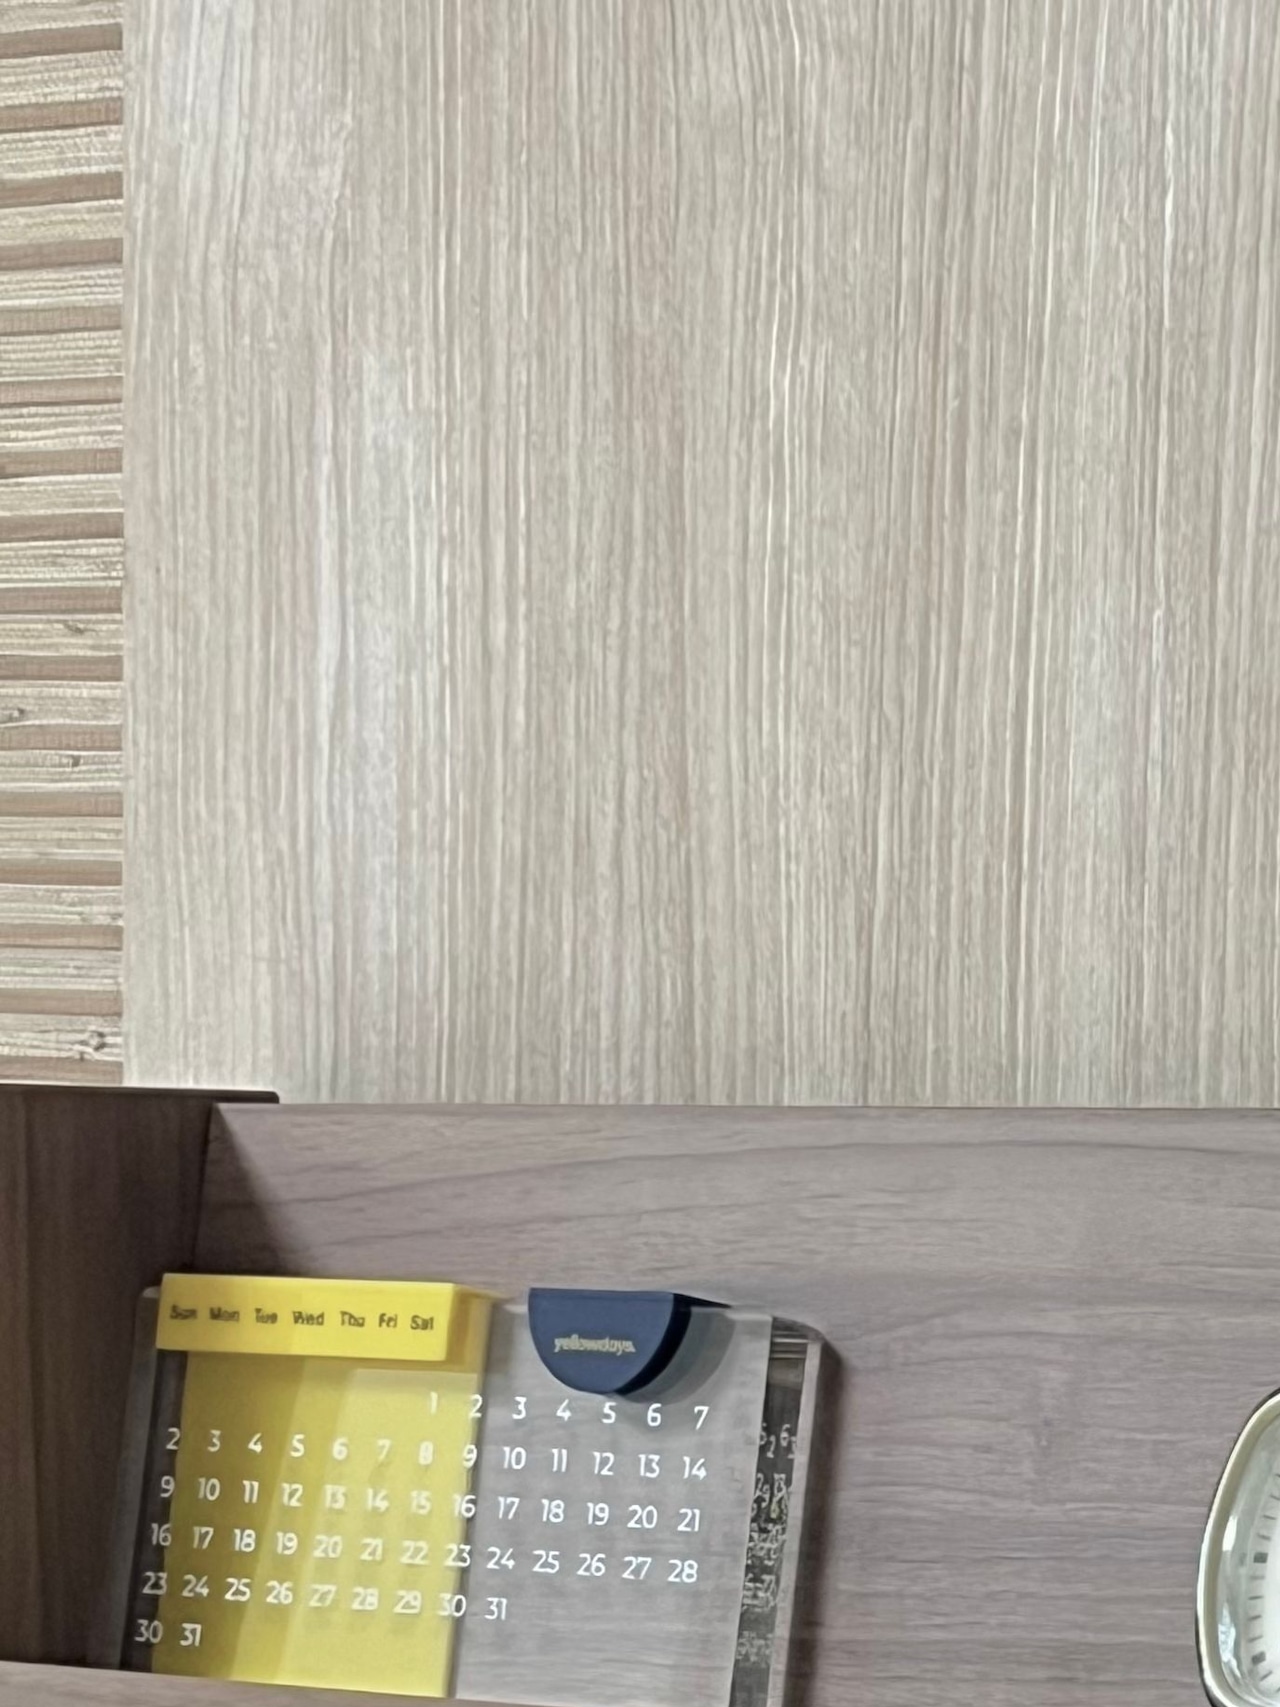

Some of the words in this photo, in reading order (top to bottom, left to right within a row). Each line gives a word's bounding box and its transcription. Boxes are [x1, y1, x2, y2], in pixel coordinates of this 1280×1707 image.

[378, 1313, 397, 1329] Fri
[429, 1391, 437, 1414] 1
[468, 1395, 482, 1418] 2
[513, 1396, 526, 1419] 3
[556, 1399, 571, 1421] 4
[602, 1402, 616, 1423] 5
[647, 1403, 661, 1426] 6
[694, 1405, 709, 1429] 7
[166, 1428, 179, 1450] 2
[207, 1430, 220, 1452] 3
[248, 1433, 262, 1453] 4
[291, 1434, 304, 1456] 5
[333, 1437, 348, 1460] 6
[462, 1444, 477, 1468] 9
[503, 1446, 526, 1470] 10
[552, 1449, 567, 1472] 11
[594, 1452, 614, 1475] 12
[638, 1454, 660, 1477] 13
[683, 1456, 706, 1480] 14
[161, 1475, 174, 1496] 9
[199, 1478, 220, 1500] 10
[242, 1481, 258, 1503] 11
[282, 1484, 303, 1506] 12
[454, 1493, 476, 1517] 16
[498, 1497, 520, 1519] 17
[541, 1500, 564, 1522] 18
[587, 1503, 609, 1525] 19
[628, 1505, 657, 1528] 20
[677, 1508, 700, 1531] 21
[151, 1523, 171, 1546] 16
[193, 1527, 213, 1549] 17
[234, 1528, 255, 1552] 18
[276, 1531, 298, 1555] 19
[313, 1535, 342, 1558] 20
[360, 1538, 382, 1561] 21
[400, 1541, 428, 1565] 22
[445, 1545, 471, 1568] 23
[486, 1548, 515, 1570] 24
[533, 1551, 560, 1574] 25
[577, 1554, 605, 1576] 26
[622, 1557, 651, 1580] 27
[668, 1559, 698, 1583] 28
[143, 1572, 167, 1595] 23
[182, 1575, 209, 1597] 24
[225, 1578, 251, 1601] 25
[266, 1581, 292, 1605] 26
[310, 1584, 336, 1607] 27
[352, 1587, 379, 1611] 28
[394, 1590, 422, 1614] 29
[439, 1593, 466, 1617] 30
[484, 1597, 507, 1620] 31
[135, 1620, 162, 1643] 30
[180, 1623, 200, 1646] 31
